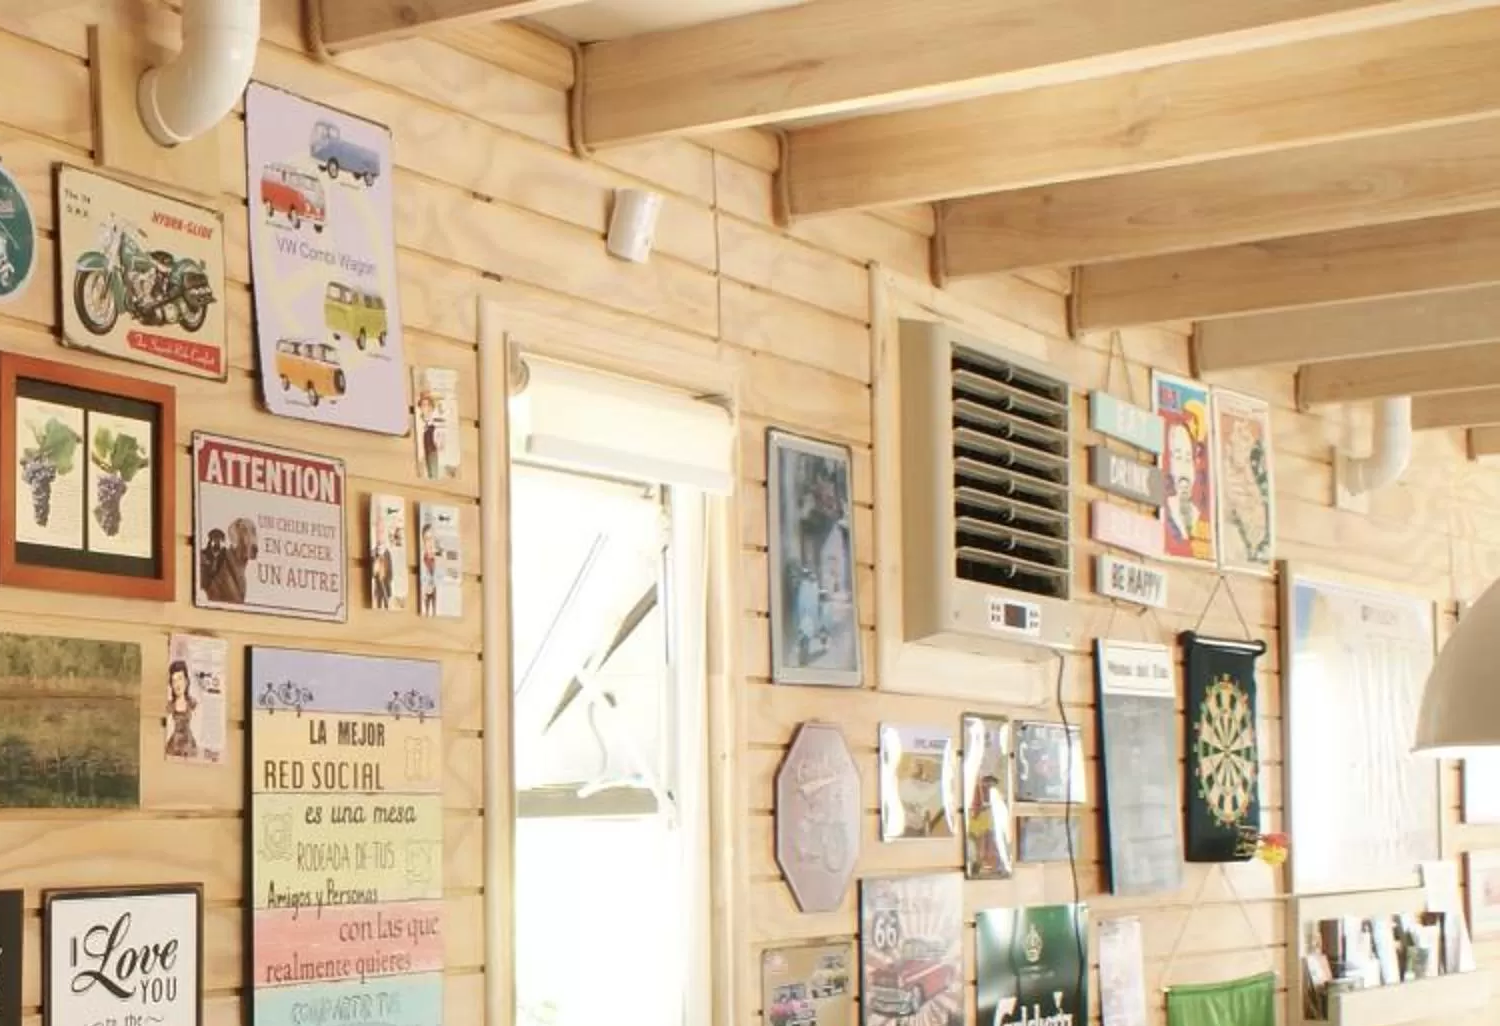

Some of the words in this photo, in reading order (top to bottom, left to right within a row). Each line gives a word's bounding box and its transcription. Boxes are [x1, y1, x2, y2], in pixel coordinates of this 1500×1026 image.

[276, 235, 297, 256] VW
[205, 448, 337, 503] ATTENTION
[1109, 455, 1151, 495] DRINK
[264, 536, 283, 556] EN
[284, 539, 334, 562] CACHER
[257, 562, 282, 585] UN
[286, 565, 339, 593] AUTRE
[1111, 562, 1125, 591] BE
[1126, 567, 1163, 602] HAPPY
[309, 719, 328, 745] LA
[337, 721, 386, 747] MEJOR
[264, 760, 305, 790] RED
[311, 761, 385, 791] SOCIAL
[304, 805, 323, 825] es
[331, 805, 366, 825] una
[372, 805, 417, 825] mesa
[297, 841, 350, 873] RODEADA
[267, 879, 311, 921] Amigos
[315, 890, 323, 920] y
[326, 877, 379, 907] Personas
[338, 918, 372, 942] con
[377, 911, 403, 941] las
[407, 915, 440, 945] que
[874, 914, 898, 951] 66
[69, 935, 78, 968] I
[71, 911, 179, 999] Love
[266, 951, 351, 984] realmente
[355, 950, 412, 985] quieres
[140, 975, 178, 1005] YOU
